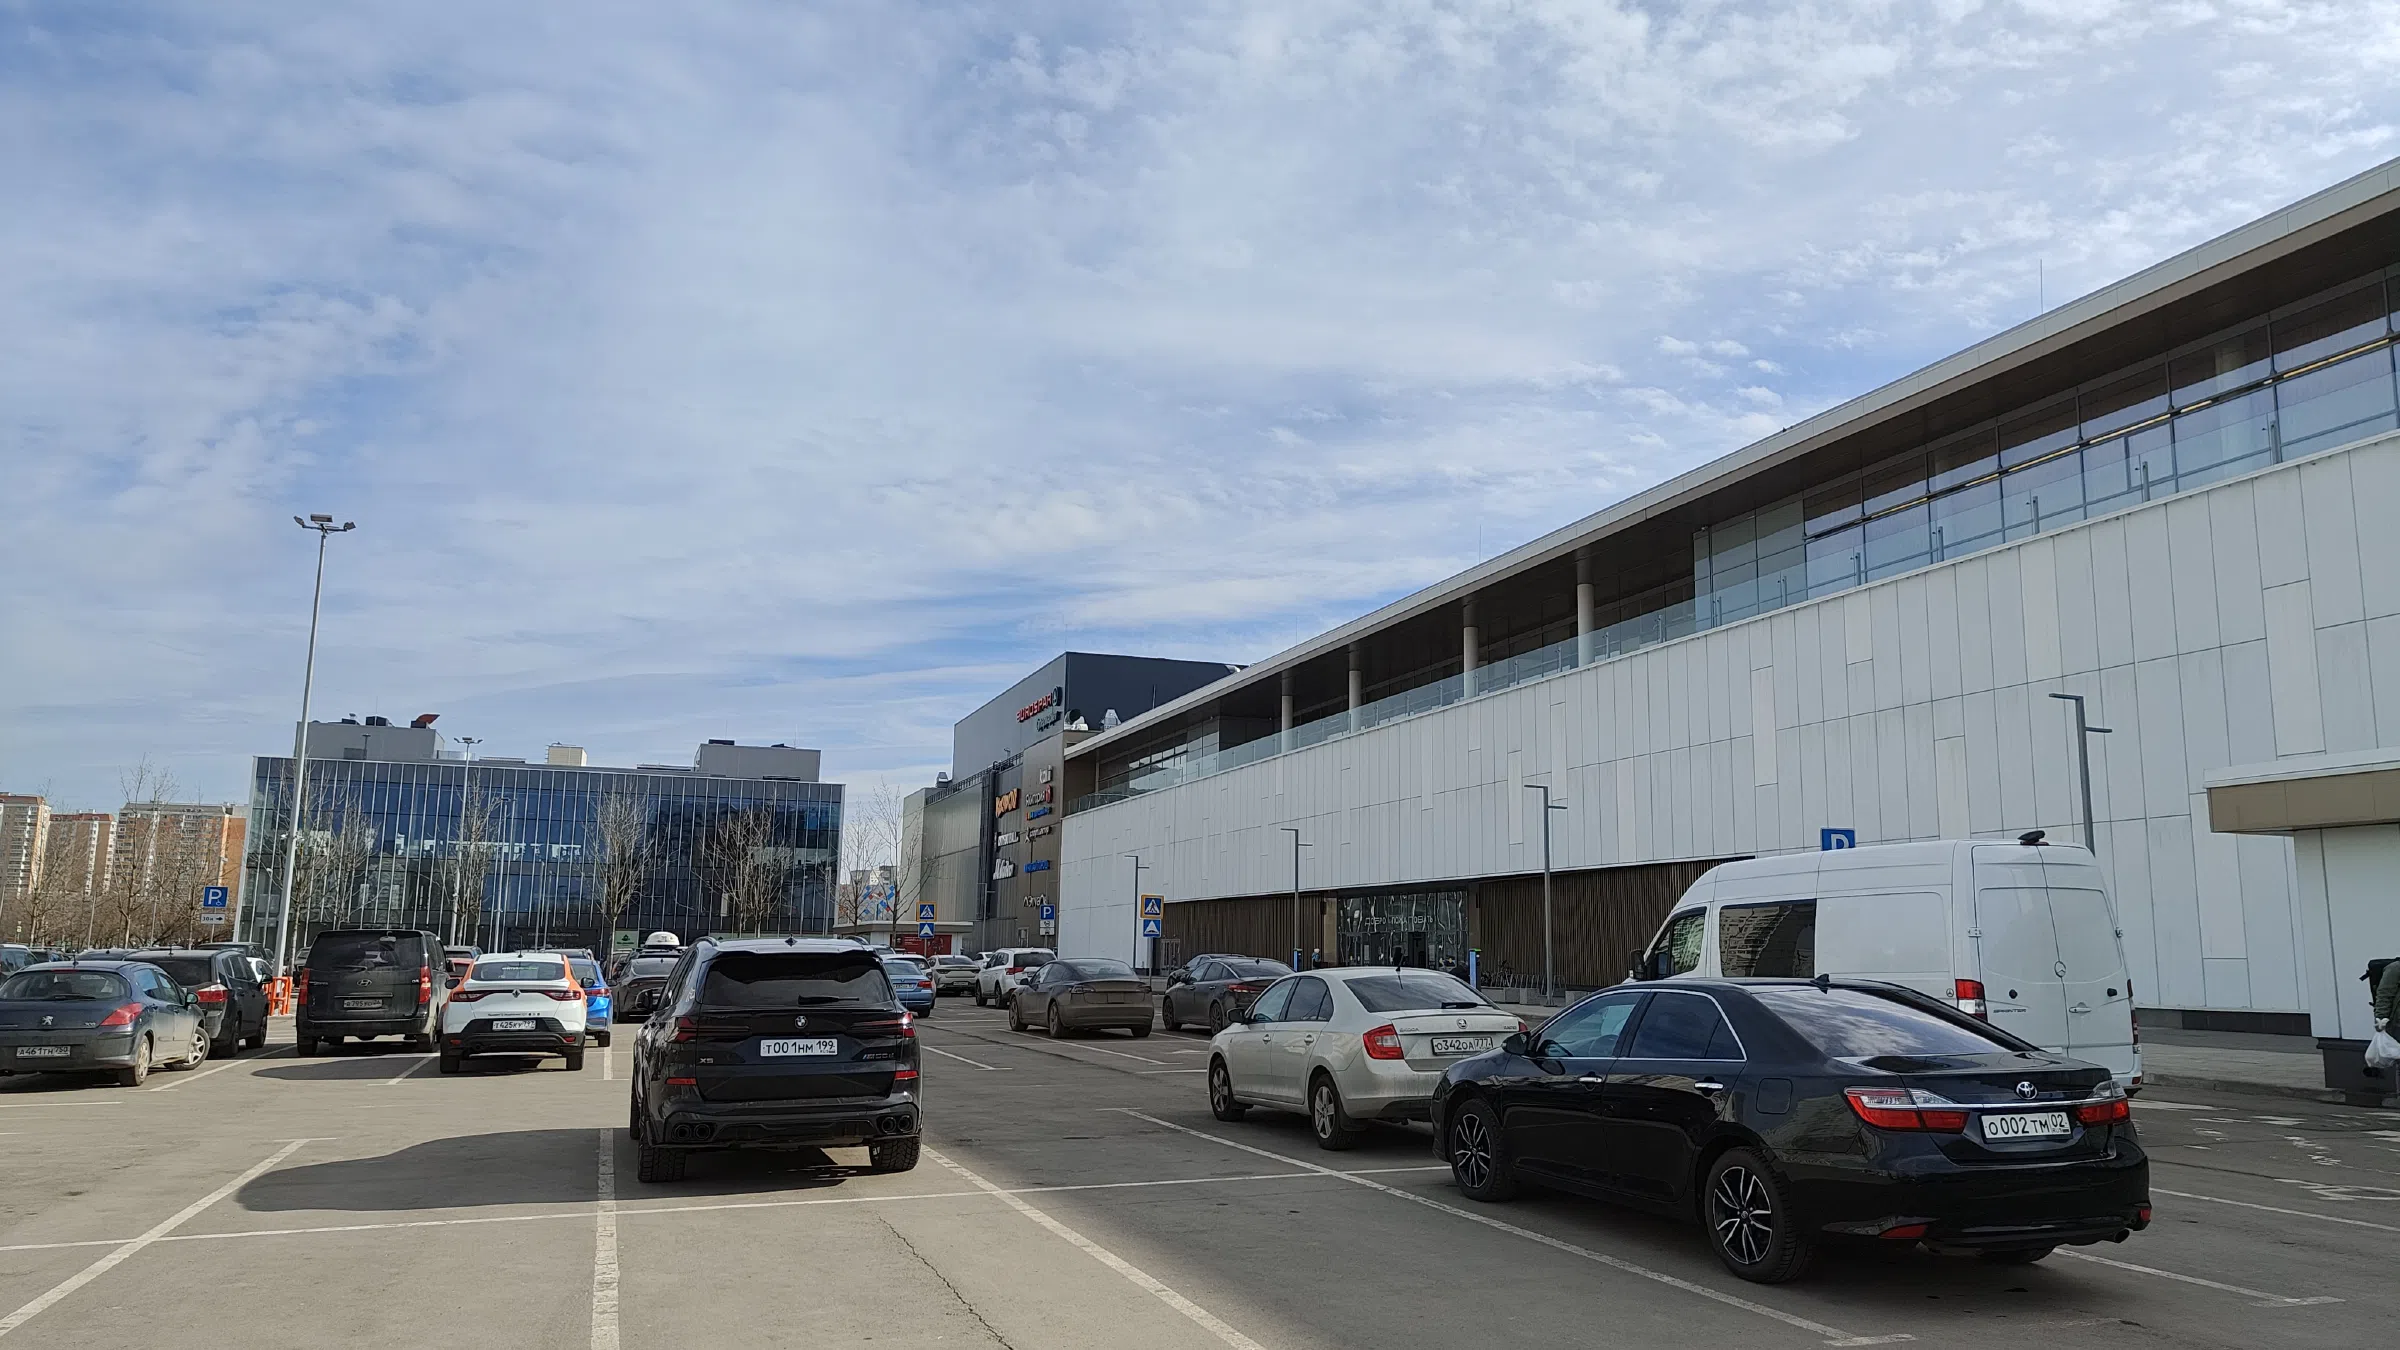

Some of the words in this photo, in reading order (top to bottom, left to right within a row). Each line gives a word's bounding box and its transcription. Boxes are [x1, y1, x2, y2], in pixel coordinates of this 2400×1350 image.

[208, 889, 222, 905] P
[1043, 907, 1052, 919] P
[816, 1040, 834, 1050] 199
[1988, 1116, 2050, 1136] О002ТМ
[2050, 1113, 2065, 1128] 02
